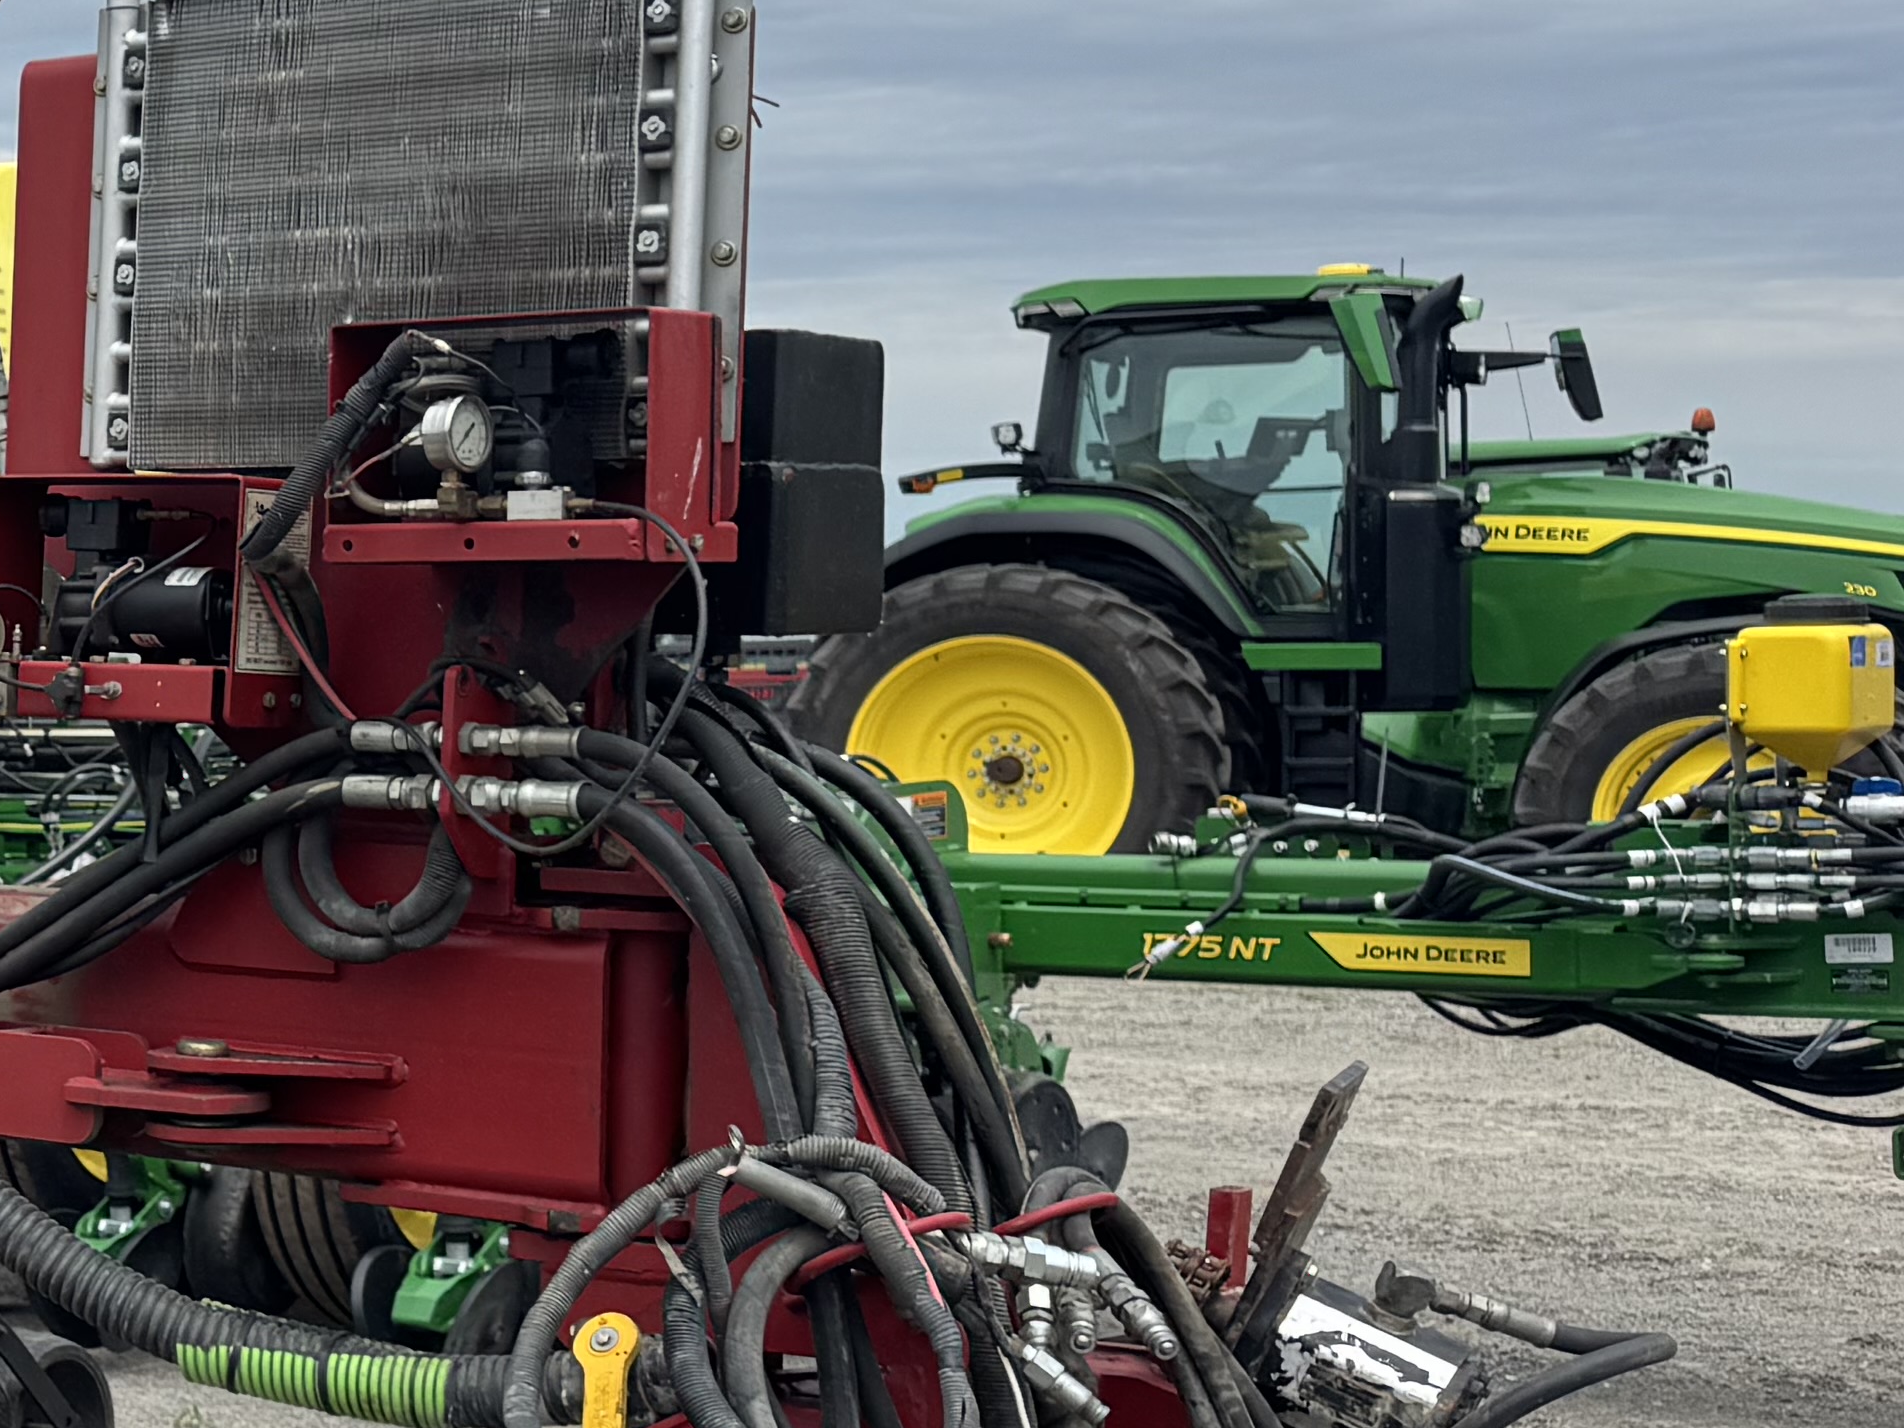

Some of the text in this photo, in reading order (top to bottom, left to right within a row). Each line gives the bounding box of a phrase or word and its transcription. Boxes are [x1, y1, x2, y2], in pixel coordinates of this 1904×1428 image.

[1514, 523, 1590, 542] DEERE
[1228, 935, 1282, 961] NT
[1355, 941, 1507, 965] JOHN DEERE
